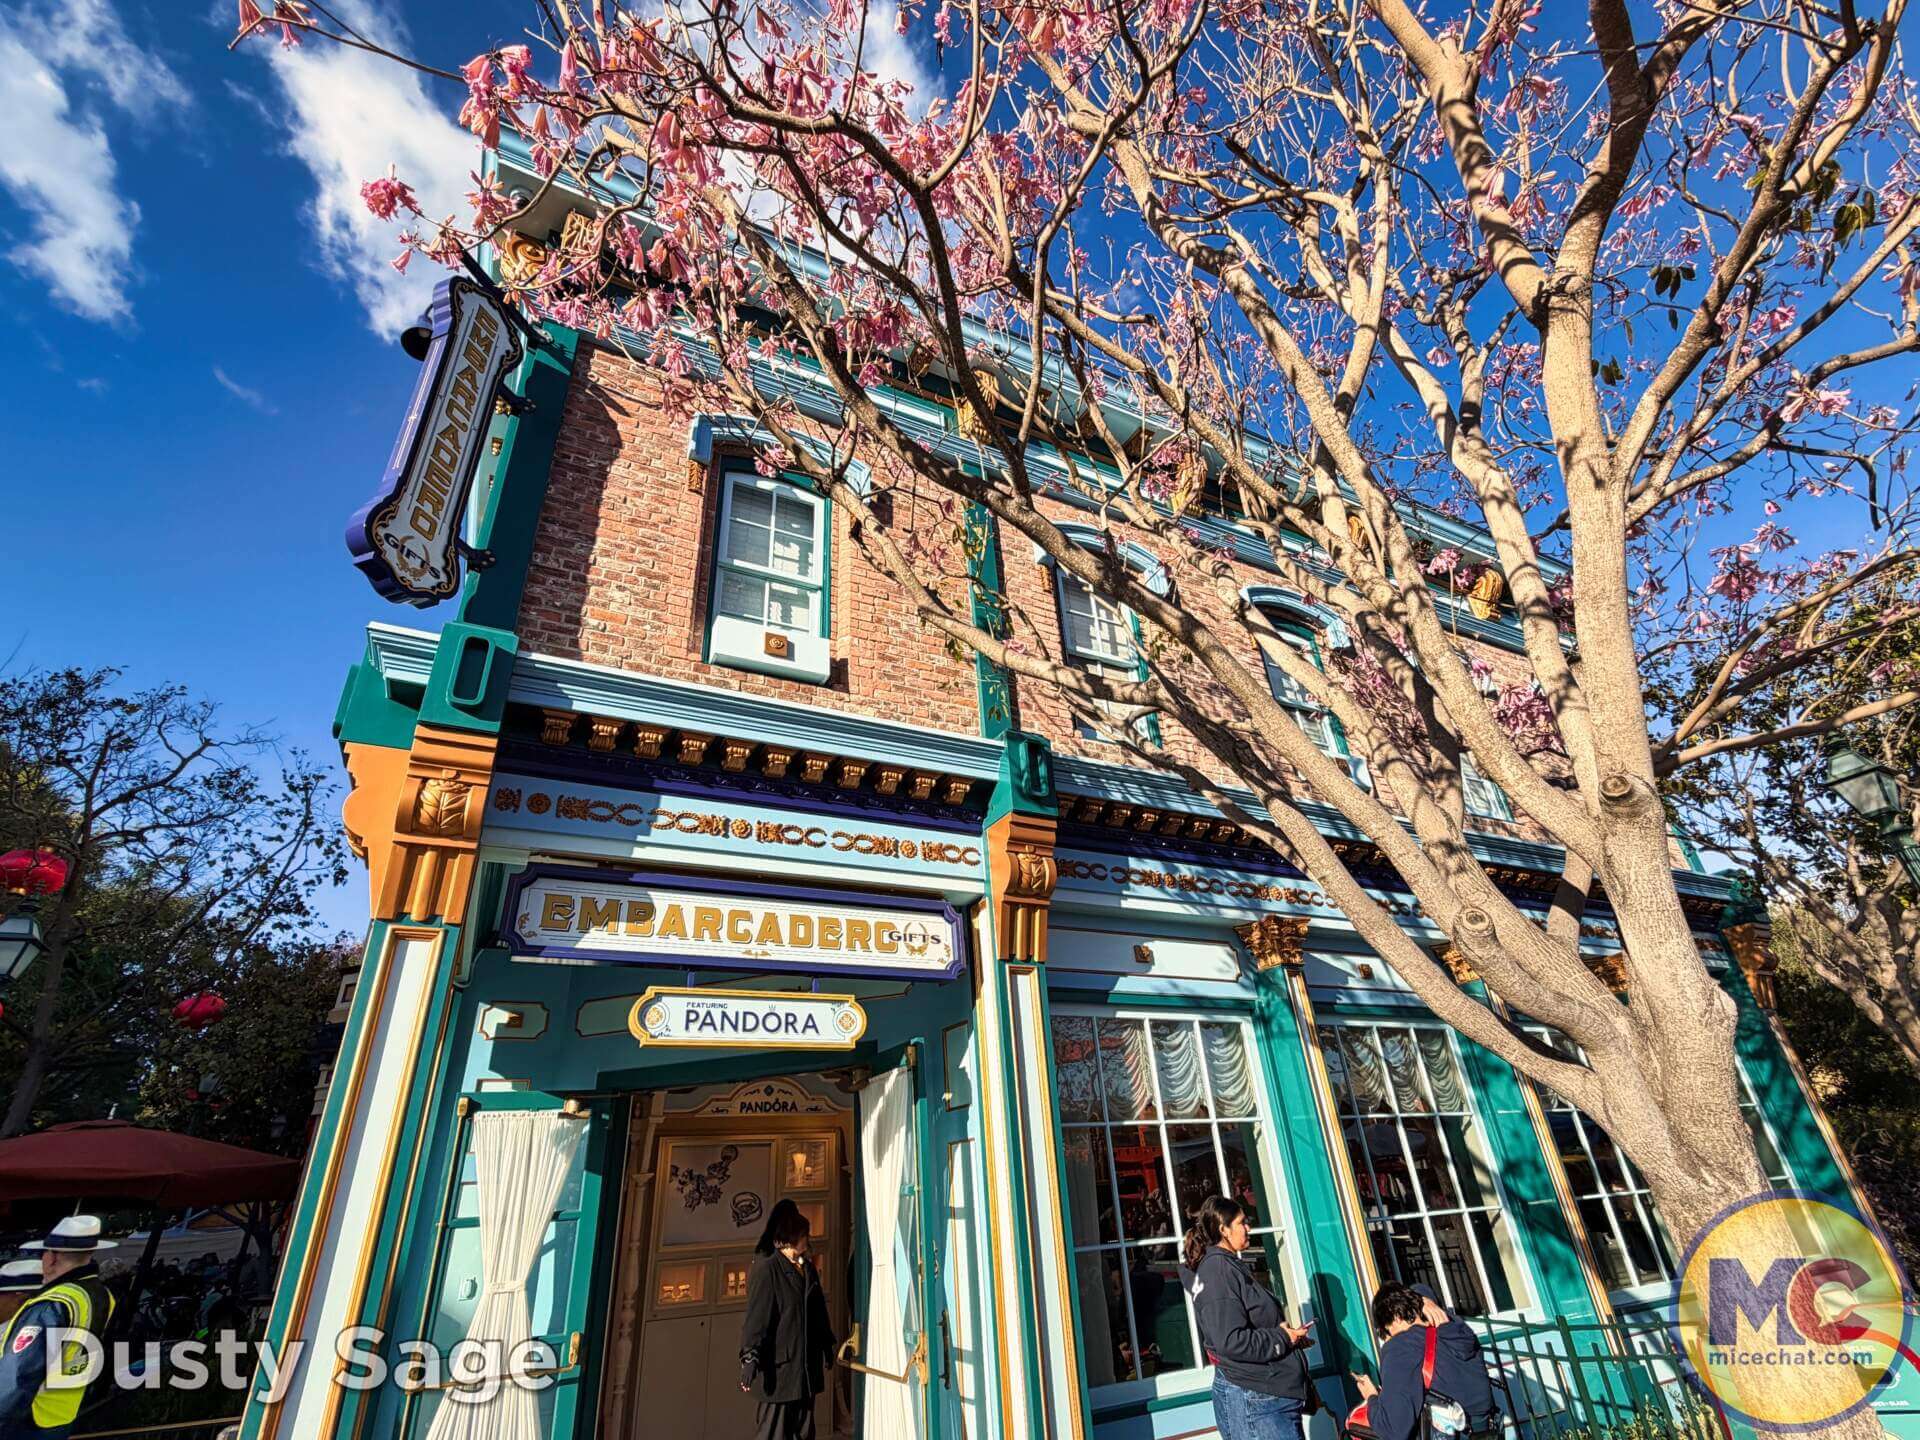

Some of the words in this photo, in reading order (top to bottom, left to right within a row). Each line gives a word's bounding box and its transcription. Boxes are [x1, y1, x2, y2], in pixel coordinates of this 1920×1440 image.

[410, 304, 499, 542] EMBARCADERO
[383, 533, 440, 580] GIFTS
[888, 930, 941, 945] GIFTS
[686, 1001, 728, 1009] FEATURING
[684, 1008, 820, 1036] PANDORA
[739, 1099, 799, 1113] PANDORA
